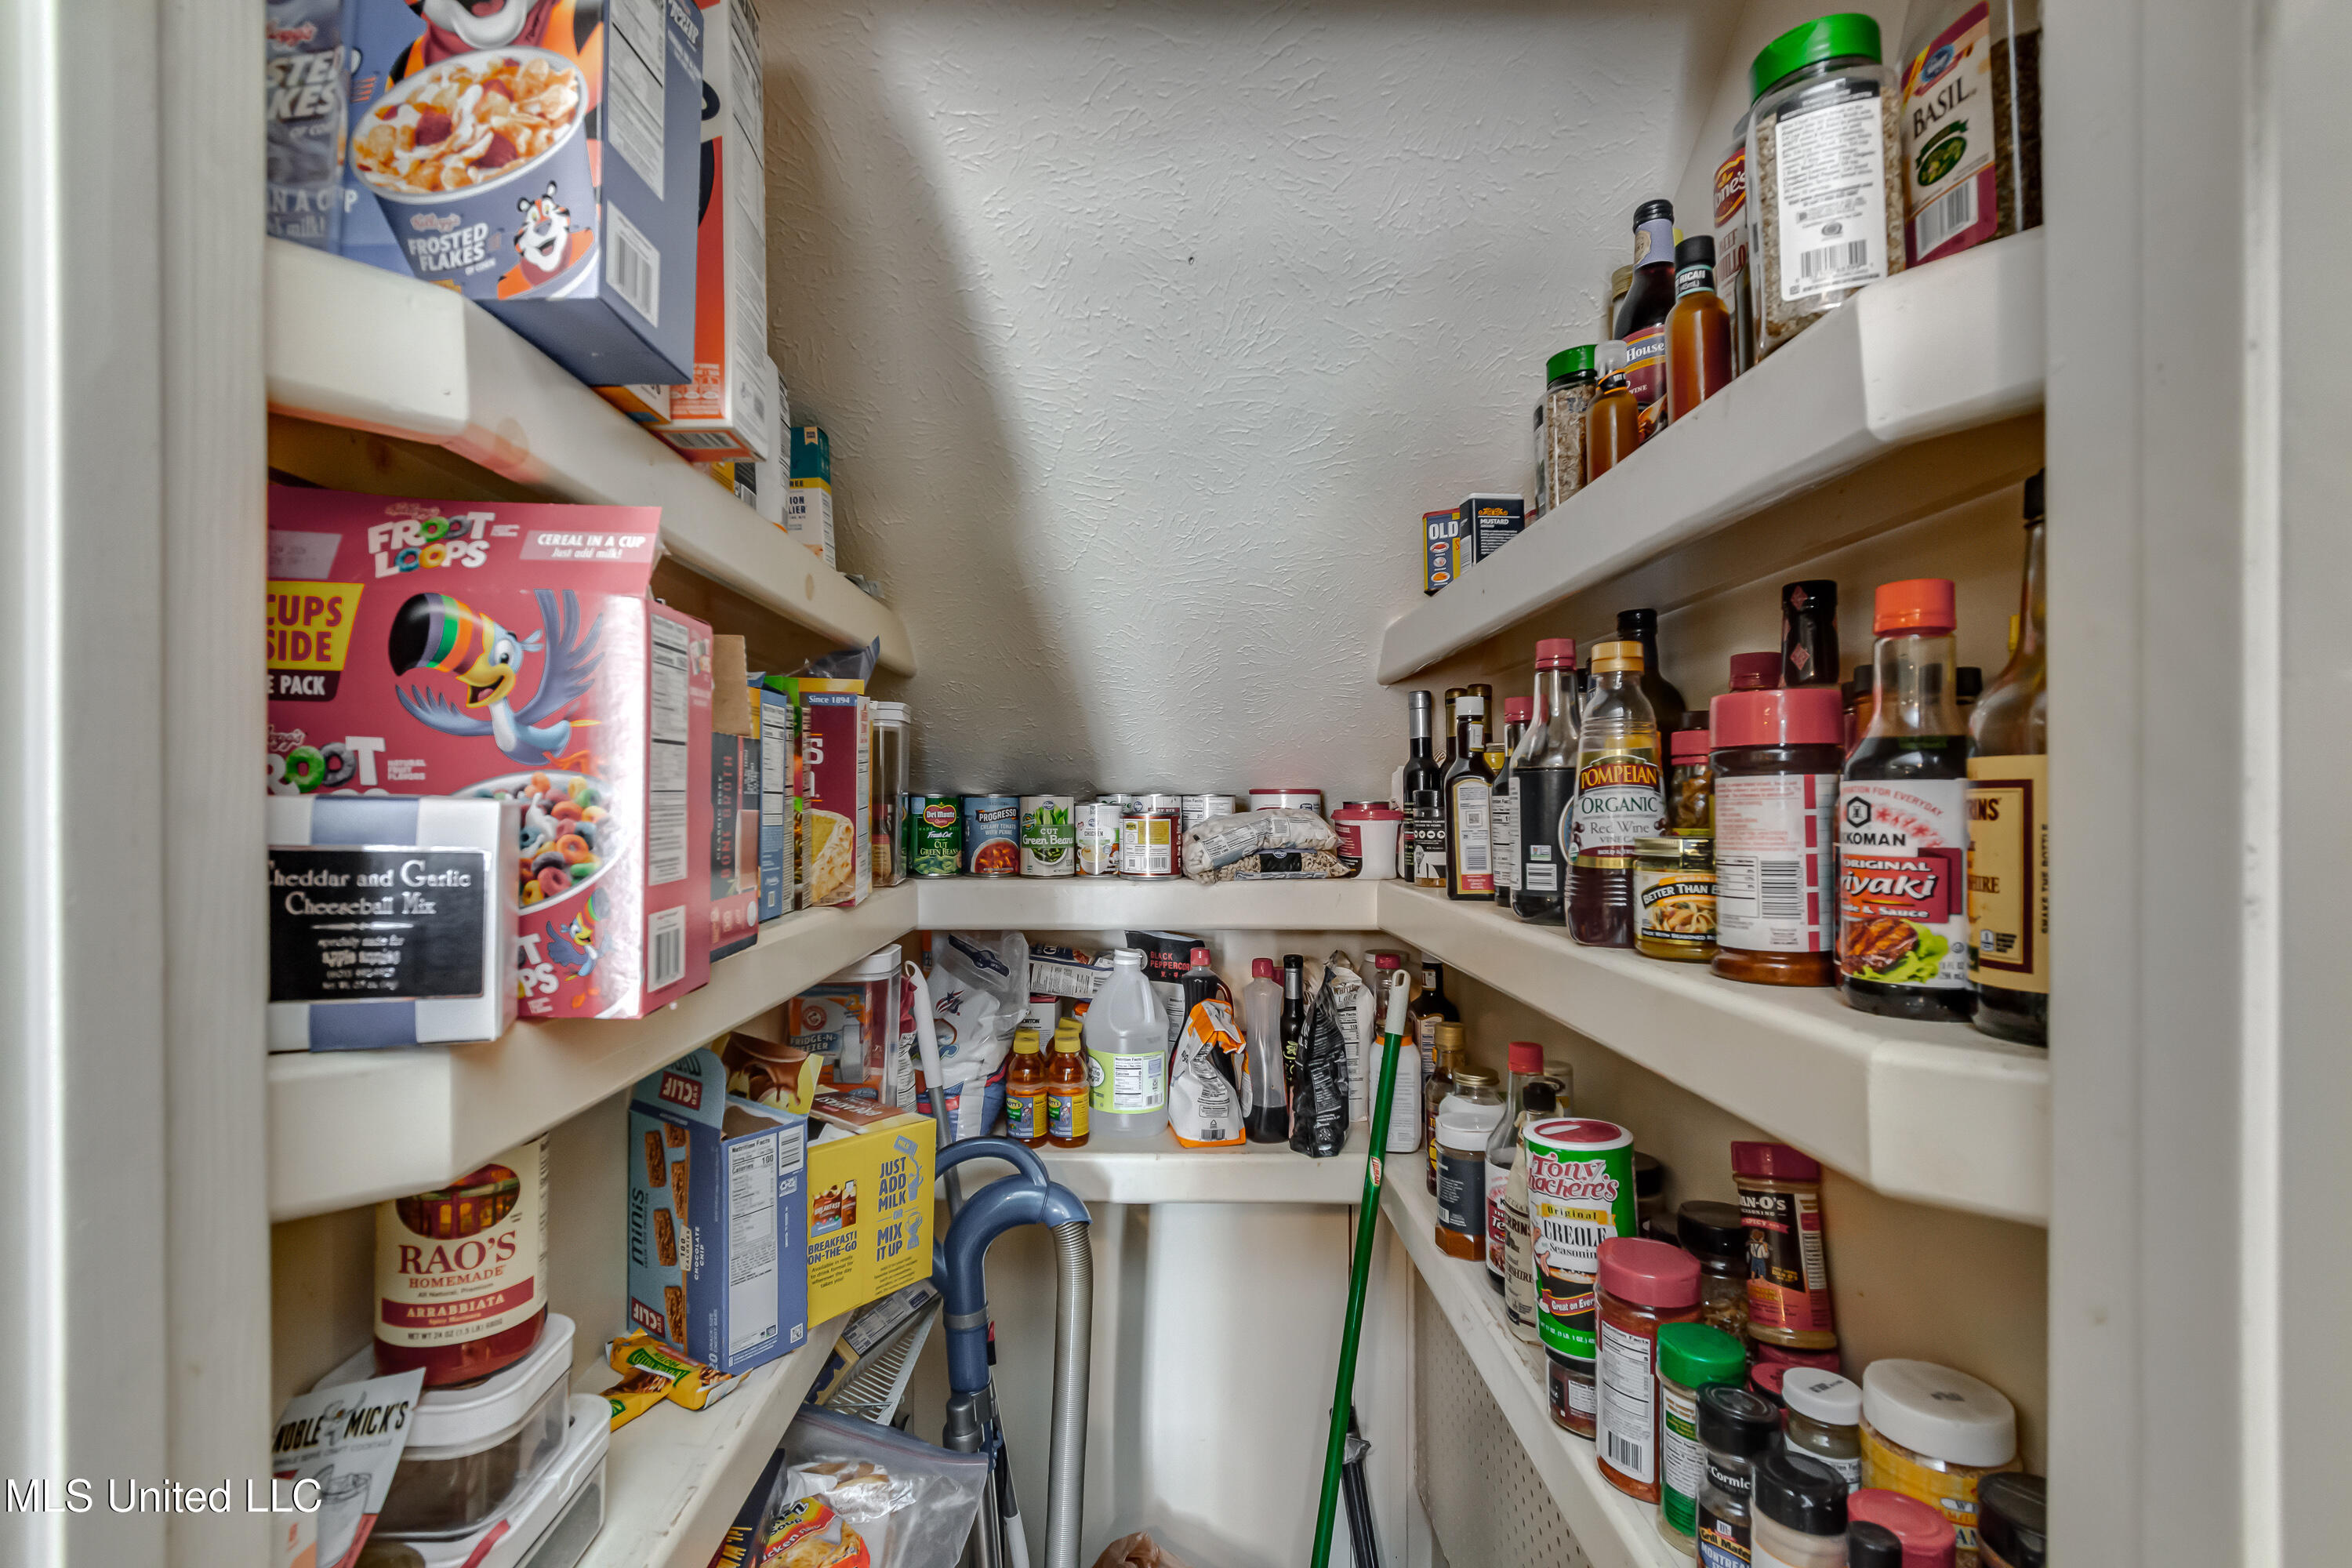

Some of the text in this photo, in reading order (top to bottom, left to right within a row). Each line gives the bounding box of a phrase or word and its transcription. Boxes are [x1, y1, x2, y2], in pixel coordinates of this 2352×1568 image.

[1913, 77, 1976, 140] BASIL
[408, 223, 488, 256] FROSTED
[419, 242, 485, 271] FLAKES
[1626, 343, 1665, 362] House
[368, 512, 495, 554] FROOT
[537, 534, 646, 548] CEREAL IN A CUP
[1428, 521, 1458, 540] OLD
[375, 540, 490, 578] LOOPS
[550, 548, 622, 559] Just add milk!
[280, 675, 325, 696] PACK
[722, 755, 733, 818] BROTH
[1581, 764, 1657, 790] POMPEIAN
[1581, 797, 1657, 815] ORGANIC
[1873, 787, 1944, 816] FOR EVERYDAY
[979, 808, 1017, 822] PROGRESSO
[1617, 821, 1650, 833] Wine
[1022, 834, 1073, 844] Green Beans
[720, 830, 732, 879] BONE
[1844, 859, 1932, 871] ORIGINAL
[357, 870, 394, 887] and
[401, 860, 471, 887] Garlic
[285, 891, 437, 915] Cheeseball Mix
[1642, 884, 1708, 903] BETTER THAN
[1878, 907, 1929, 918] Sauce
[1150, 951, 1173, 960] BLACK
[790, 1033, 837, 1044] FRIDGE-N-
[662, 1077, 693, 1103] CLIF
[732, 1138, 771, 1153] Nutrition Facts
[732, 1154, 774, 1174] Calories 100
[879, 1156, 906, 1179] JUST
[1532, 1153, 1602, 1181] Tony
[878, 1173, 906, 1196] ADD
[878, 1189, 906, 1213] MILK
[893, 1208, 903, 1220] OR
[1548, 1205, 1597, 1221] Original
[632, 1187, 645, 1267] minis
[877, 1221, 902, 1247] MIX
[397, 1230, 516, 1275] RAO'S
[808, 1240, 857, 1265] ON-THE-GO
[877, 1240, 903, 1262] IT UP
[409, 1267, 504, 1288] HOMEMADE
[811, 1261, 833, 1274] Available
[811, 1276, 834, 1286] whenever
[844, 1268, 852, 1276] day
[817, 1269, 829, 1278] drink
[831, 1264, 847, 1272] format
[406, 1294, 504, 1318] ARRABBIATA
[633, 1303, 657, 1330] CLIF
[1552, 1300, 1569, 1312] Great
[1570, 1301, 1578, 1310] on
[408, 1331, 419, 1341] NET
[421, 1330, 431, 1339] WT
[444, 1329, 454, 1338] OZ
[1603, 1322, 1650, 1345] Nutrition Facts
[272, 1415, 325, 1454] NOBLE
[343, 1400, 409, 1439] MICK'S
[770, 1518, 803, 1537] Soup
[1700, 1529, 1718, 1543] Grill
